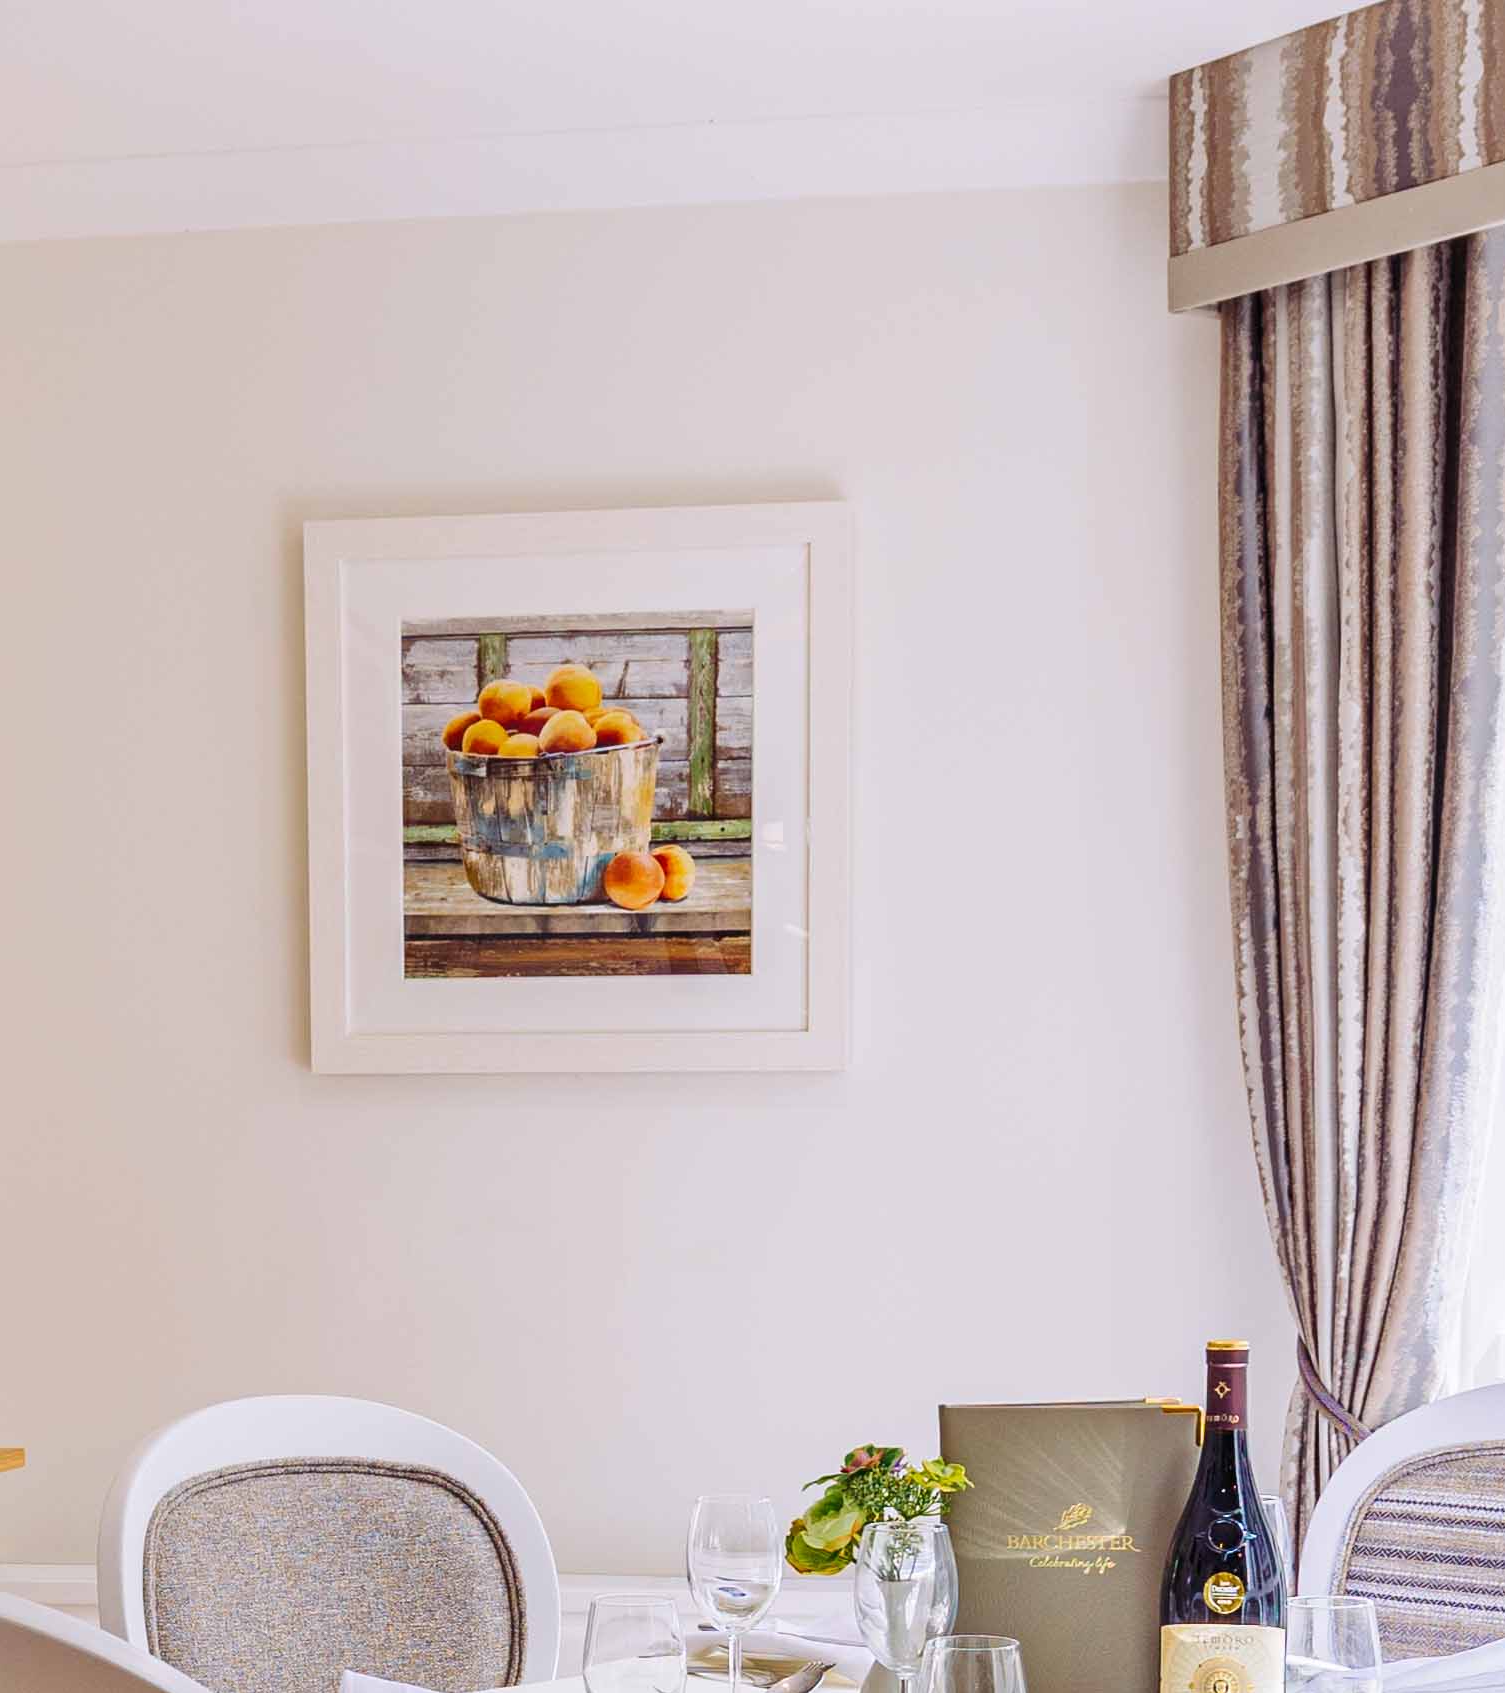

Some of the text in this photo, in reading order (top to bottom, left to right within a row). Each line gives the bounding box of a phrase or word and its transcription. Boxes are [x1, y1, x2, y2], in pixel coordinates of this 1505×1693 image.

[1006, 1535, 1142, 1552] BARCHESTER
[1029, 1556, 1116, 1575] Celebrating life
